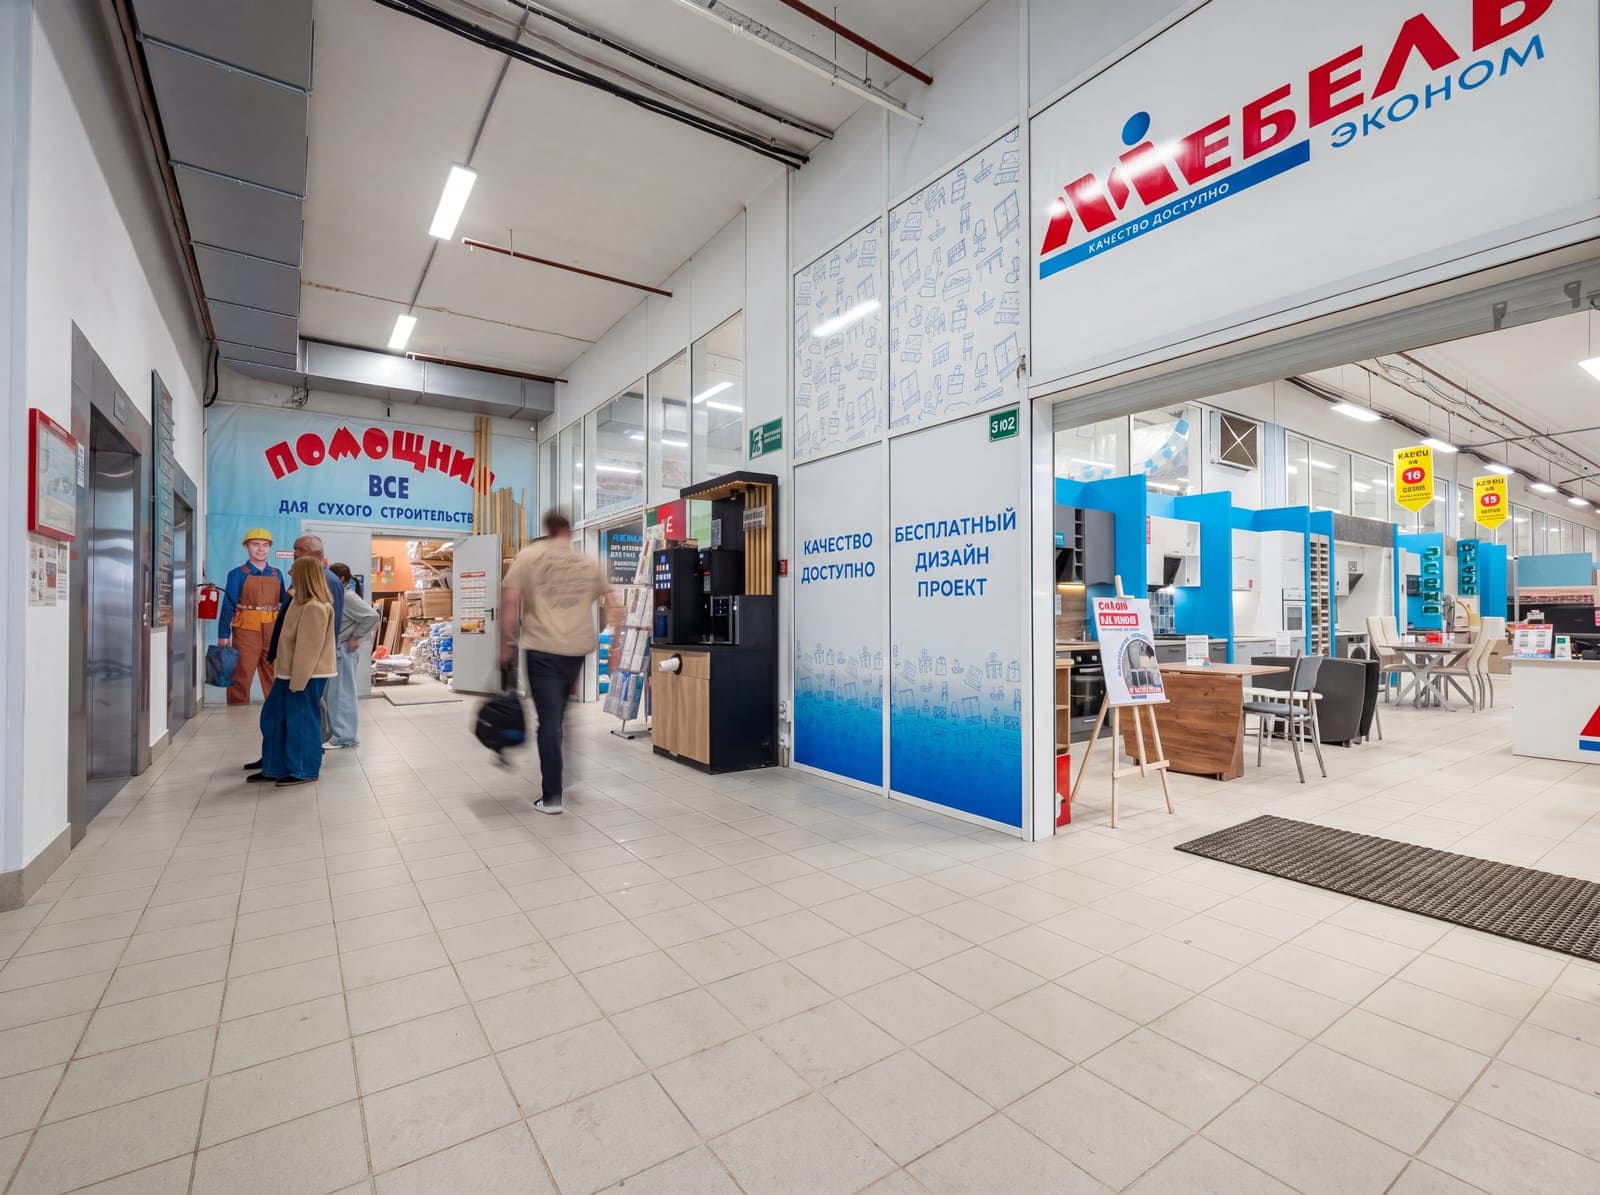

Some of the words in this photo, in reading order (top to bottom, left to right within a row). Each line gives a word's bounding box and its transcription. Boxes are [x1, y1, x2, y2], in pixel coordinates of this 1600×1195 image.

[1331, 34, 1545, 149] ЭКОНОМ
[1088, 219, 1149, 254] КАЧЕСТВО
[1152, 183, 1230, 227] ДОСТУПНО
[368, 474, 409, 499] ВСЕ
[1406, 470, 1421, 480] 16
[278, 499, 309, 515] ДЛЯ
[318, 502, 373, 518] СУХОГО
[380, 506, 474, 524] СТРОИТЕЛЬСТВ
[1484, 495, 1497, 504] 15
[894, 508, 1017, 543] БЕСПЛАТНЫЙ
[803, 532, 873, 555] КАЧЕСТВО
[914, 544, 990, 573] ДИЗАЙН
[801, 561, 876, 584] ДОСТУПНО
[917, 577, 987, 598] ПРОЕКТ
